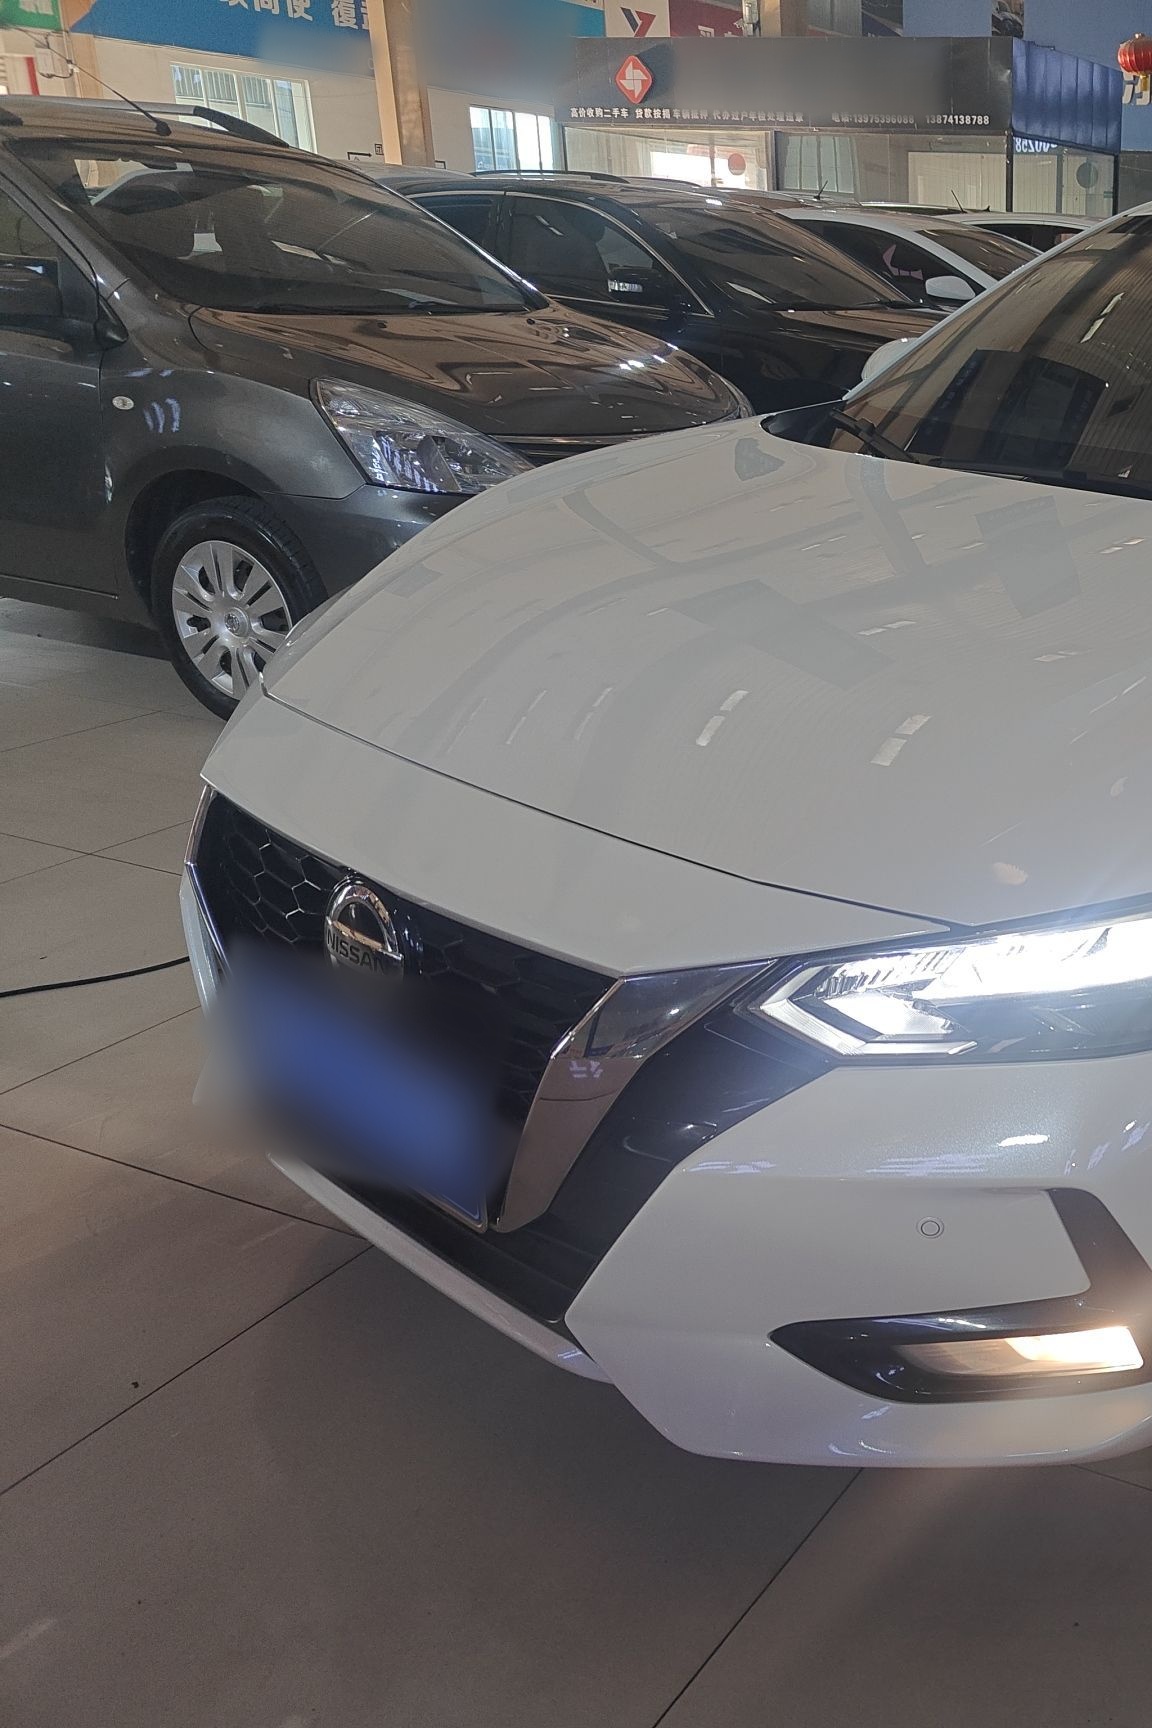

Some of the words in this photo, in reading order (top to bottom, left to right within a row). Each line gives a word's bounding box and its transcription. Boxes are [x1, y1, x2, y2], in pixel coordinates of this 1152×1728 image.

[570, 108, 629, 119] 高价收购二手车
[635, 109, 671, 119] 贷款按揭
[926, 115, 990, 125] 13874138788
[327, 928, 385, 976] NISSAN
